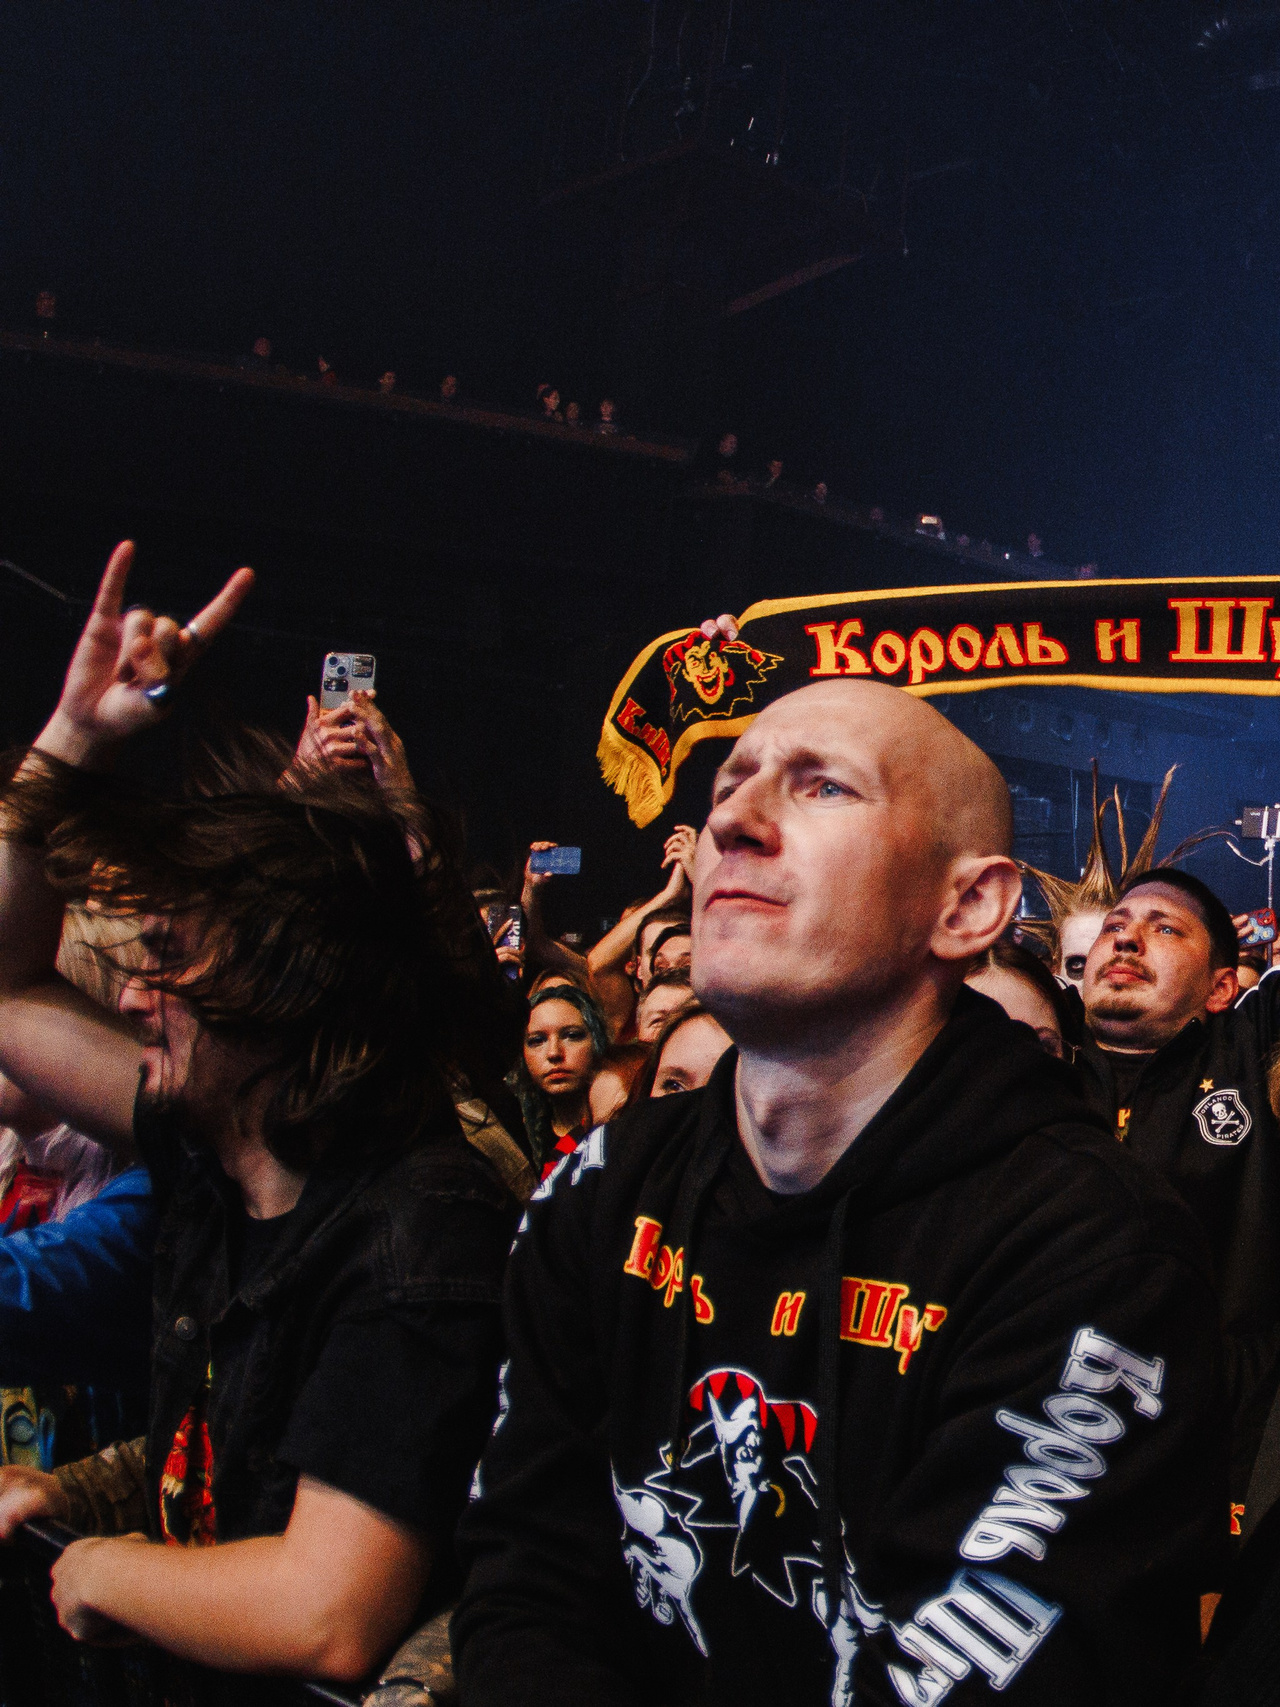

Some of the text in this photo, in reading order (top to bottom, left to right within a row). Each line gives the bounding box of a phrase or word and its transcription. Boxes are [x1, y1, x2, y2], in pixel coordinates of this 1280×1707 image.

[804, 617, 1069, 684] Король
[1095, 617, 1141, 664] и
[1201, 1096, 1233, 1114] ORLANDO
[1216, 1124, 1244, 1139] PIRATES
[770, 1291, 806, 1337] и
[959, 1327, 1166, 1562] Король
